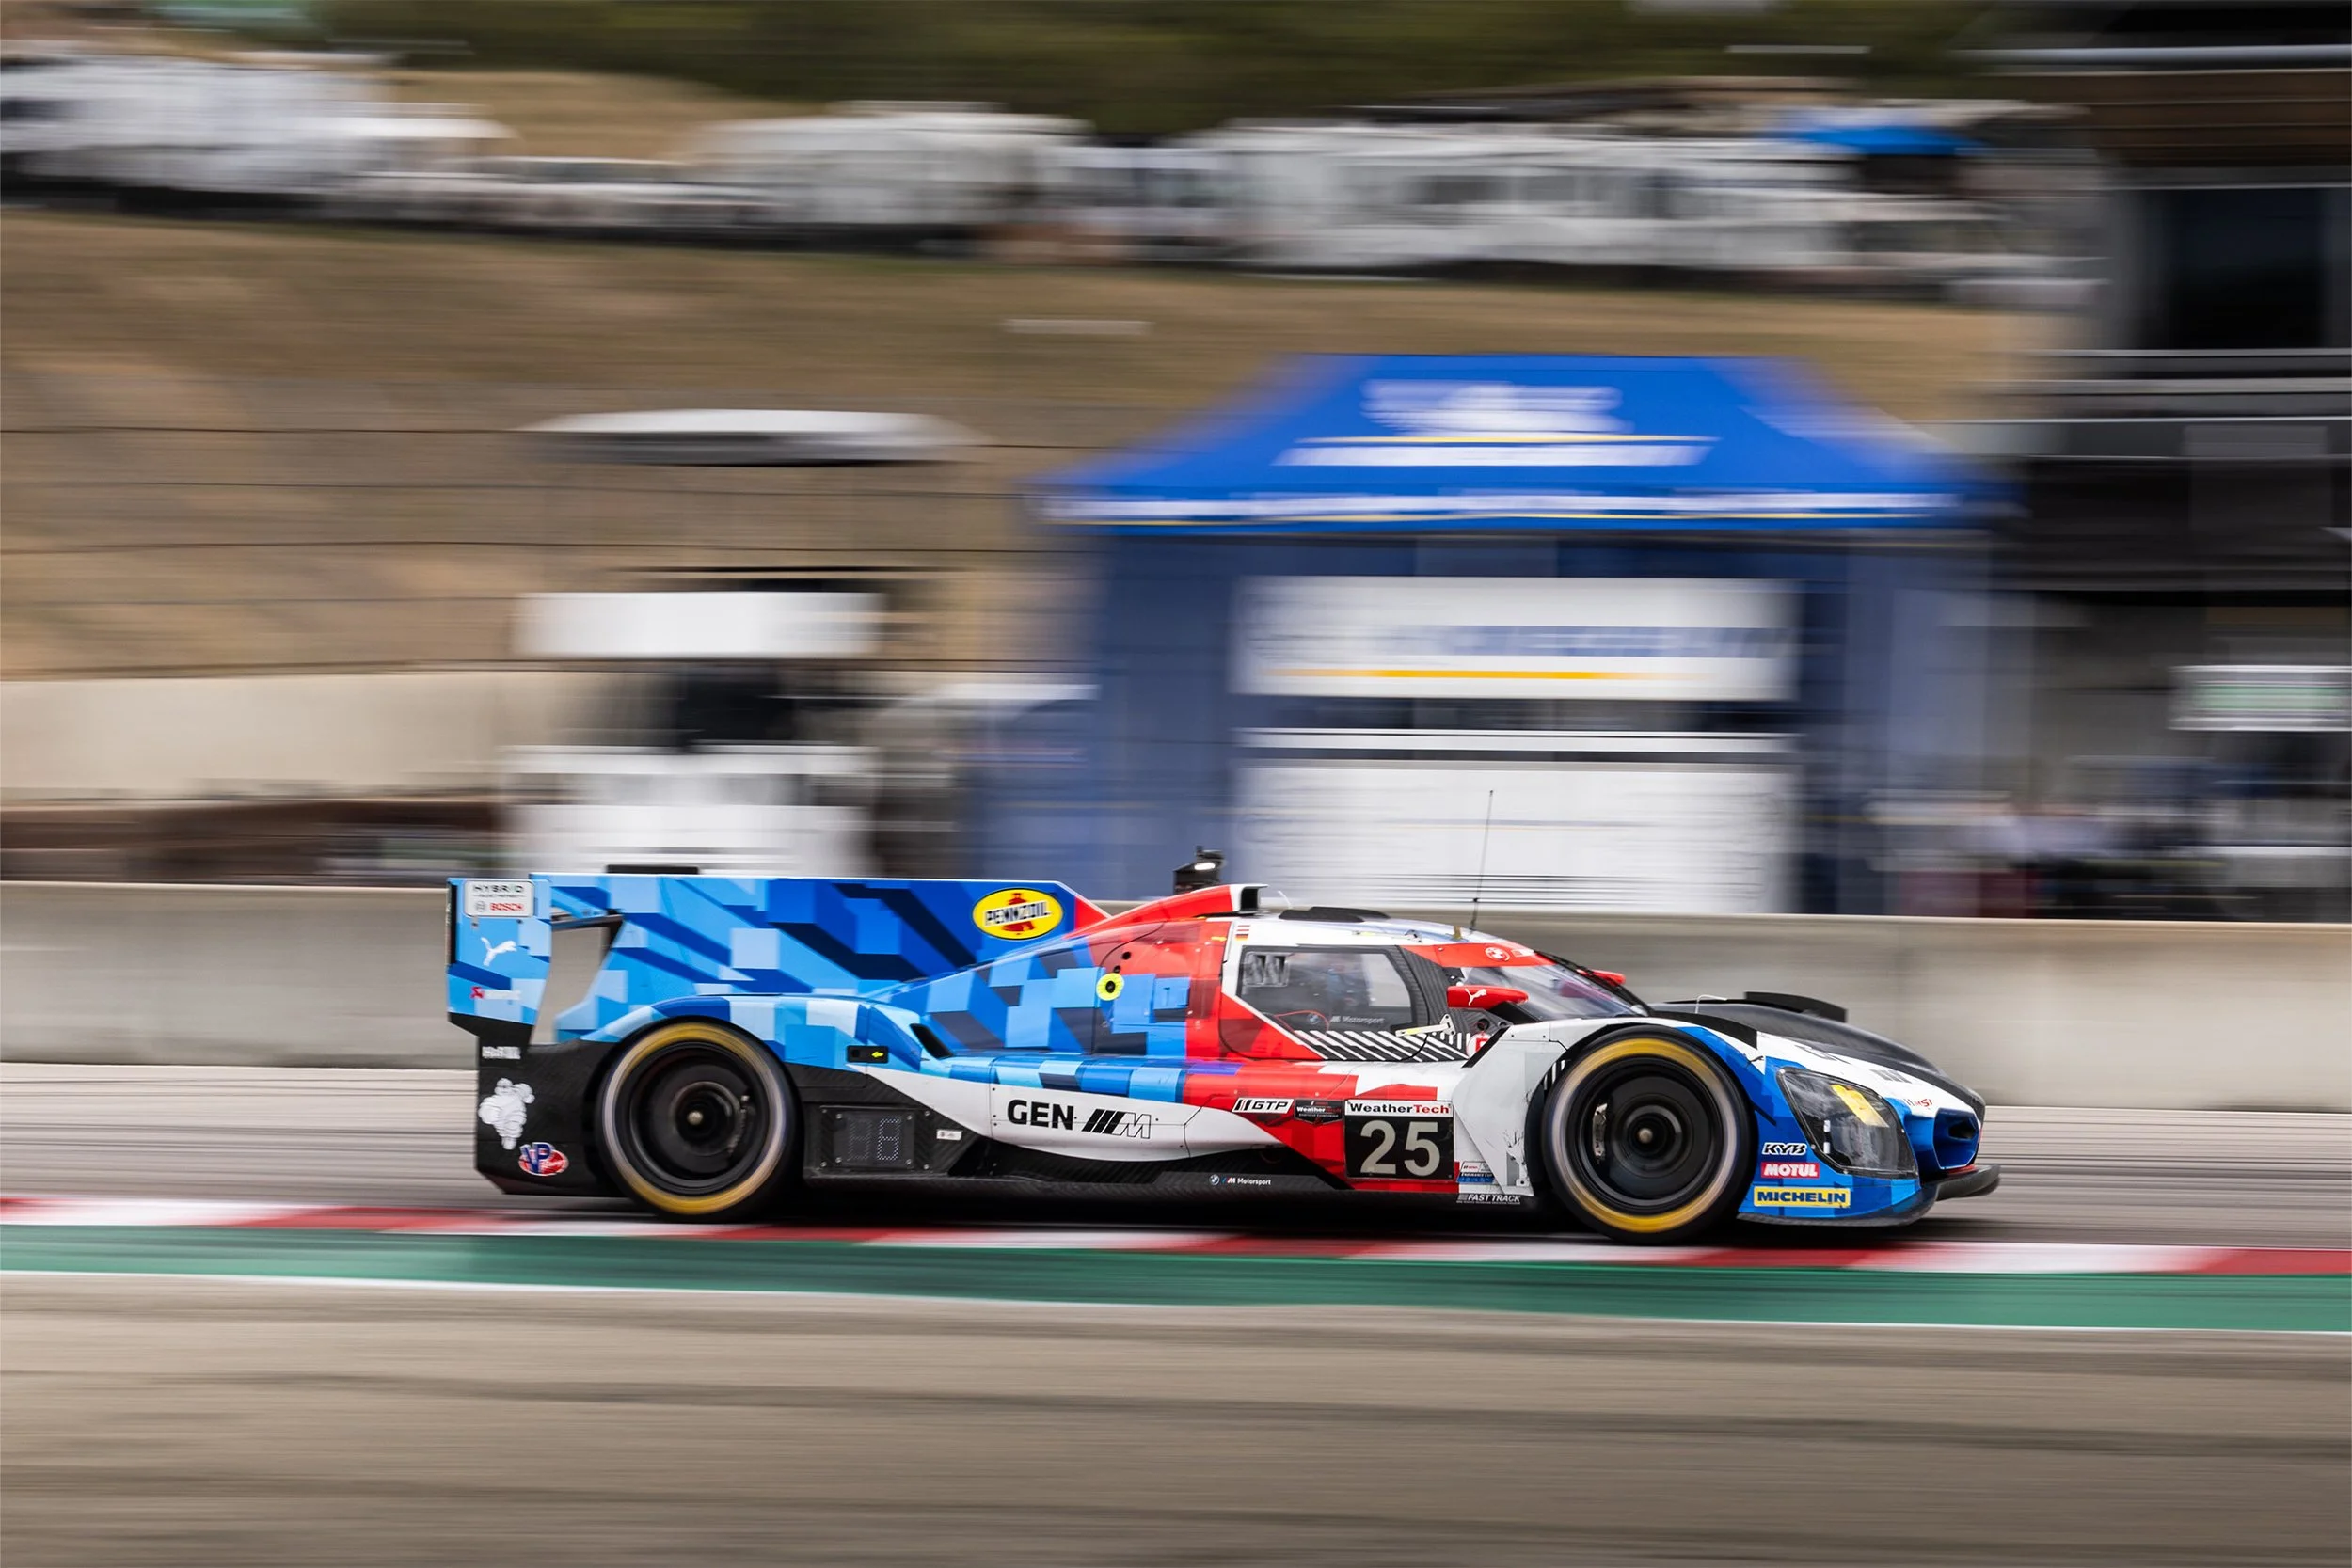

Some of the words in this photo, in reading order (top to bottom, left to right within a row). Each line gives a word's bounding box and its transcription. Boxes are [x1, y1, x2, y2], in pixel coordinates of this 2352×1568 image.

[984, 902, 1051, 927] PENNZOIL
[1252, 1101, 1289, 1110] GTP
[1350, 1103, 1449, 1114] WeatherTech
[1008, 1100, 1074, 1130] GEN
[1360, 1119, 1440, 1177] 25
[1764, 1143, 1806, 1155] KYB
[1764, 1164, 1818, 1177] MOTUL
[1237, 1177, 1271, 1185] Motorsport
[1757, 1192, 1846, 1203] MICHELIN
